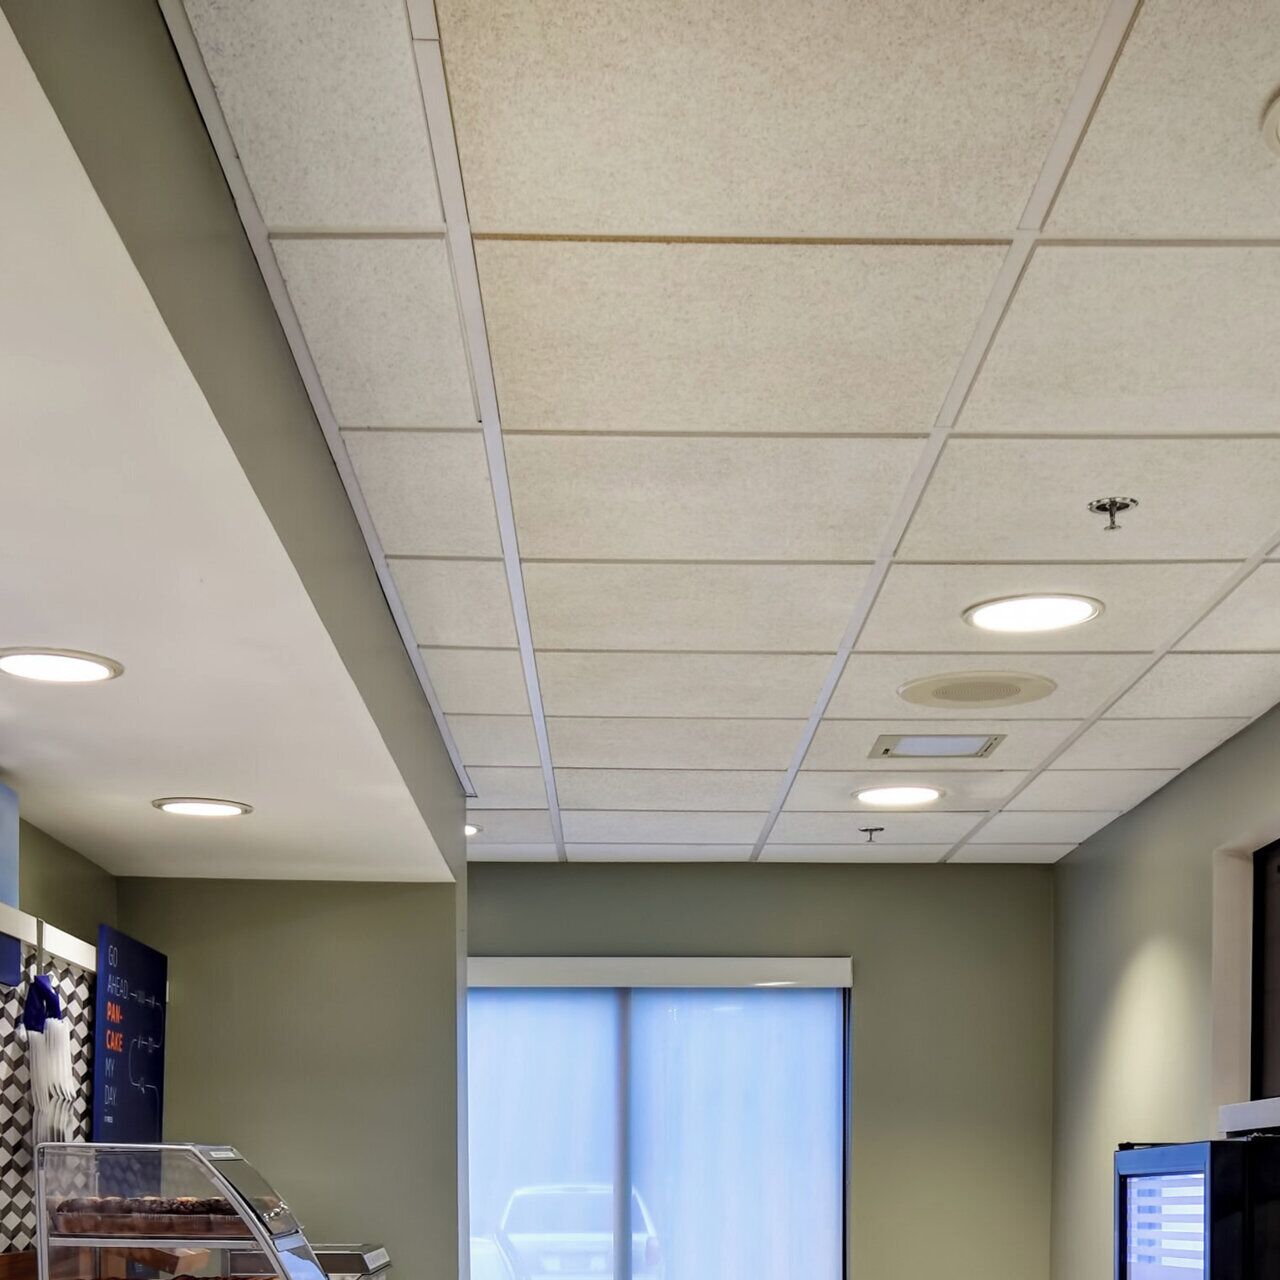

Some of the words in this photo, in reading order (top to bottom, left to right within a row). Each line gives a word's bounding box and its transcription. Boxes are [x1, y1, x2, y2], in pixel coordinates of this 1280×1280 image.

[108, 945, 119, 968] GO
[107, 973, 129, 1000] AHEAD
[105, 1030, 124, 1053] CAKE
[104, 1084, 118, 1106] DAY
